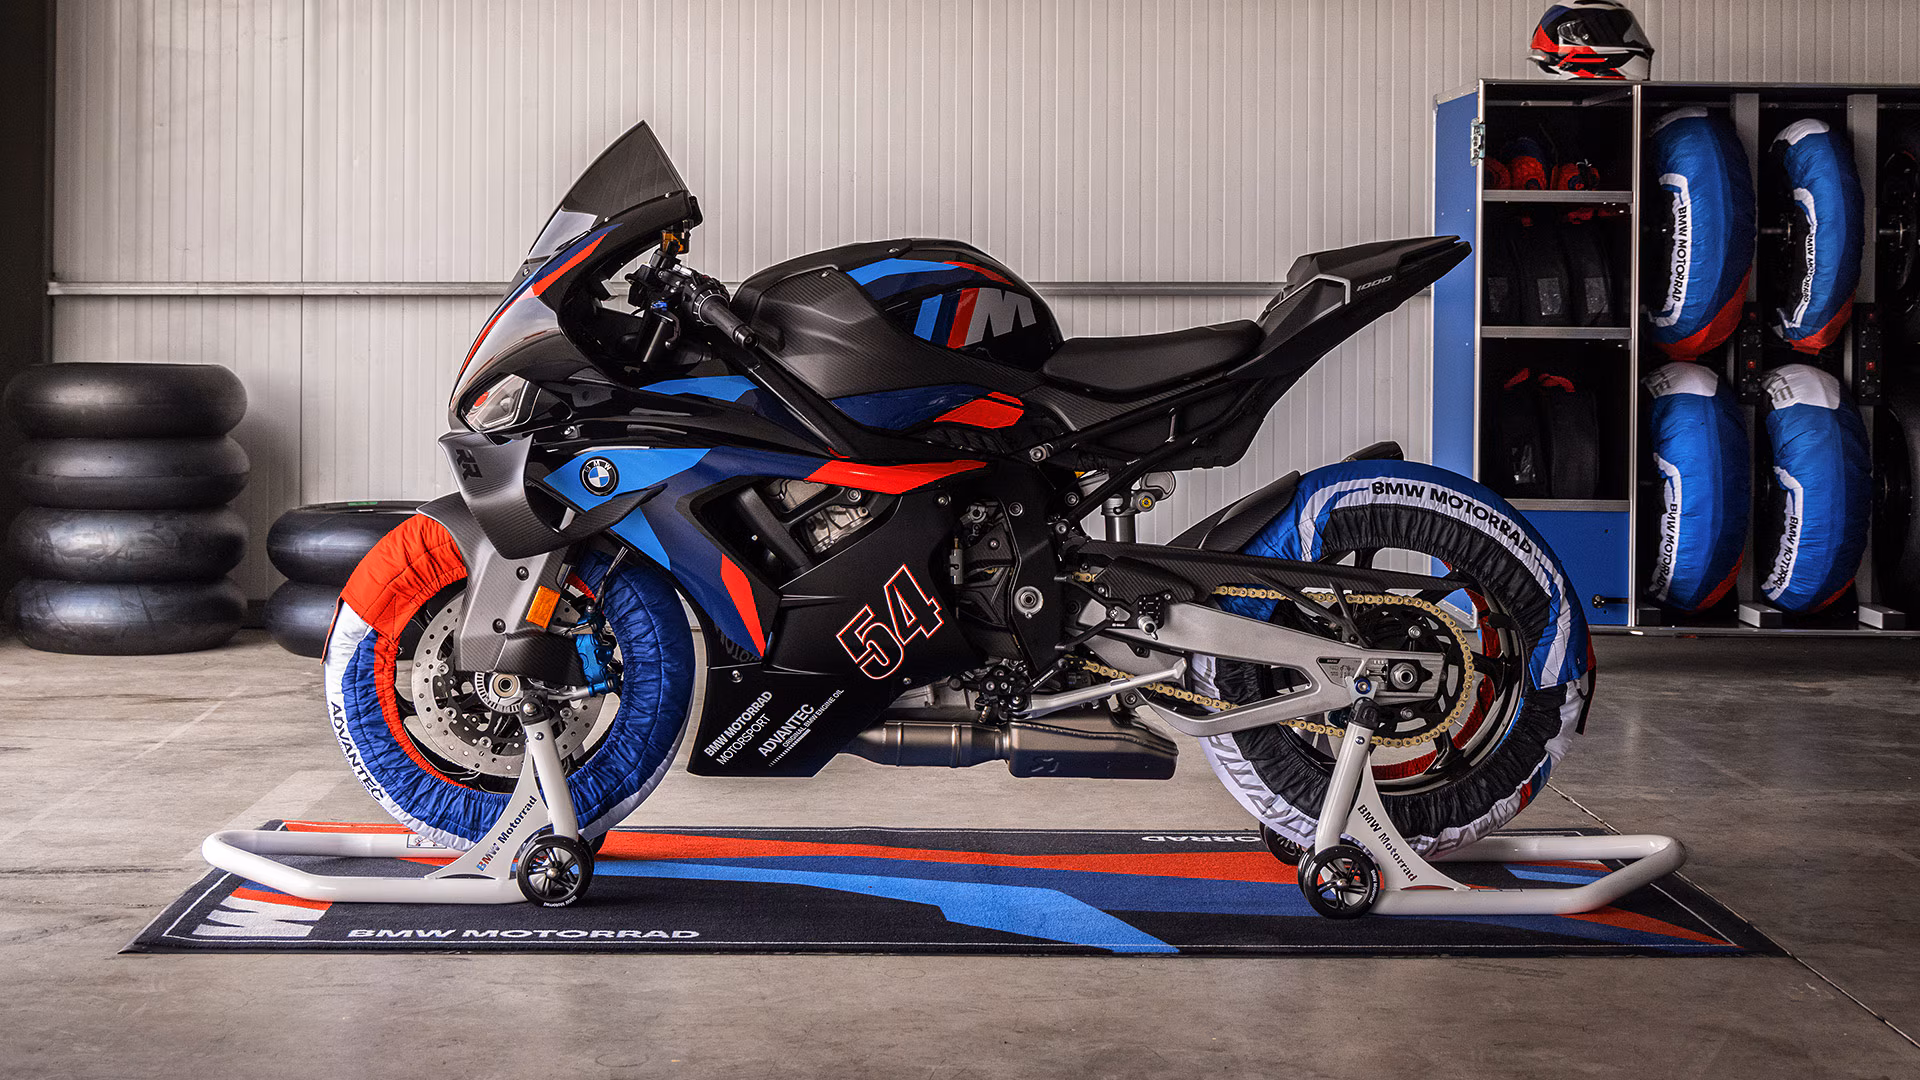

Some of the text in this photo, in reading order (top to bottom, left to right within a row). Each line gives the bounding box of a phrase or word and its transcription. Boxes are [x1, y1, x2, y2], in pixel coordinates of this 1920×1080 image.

[1356, 275, 1393, 292] 1000
[1672, 206, 1688, 302] BMW MOTORRAD
[964, 287, 1037, 346] M
[1371, 481, 1532, 554] BMW MOTORRAD
[1787, 516, 1799, 545] BMW
[836, 563, 944, 680] 54
[703, 691, 773, 757] BMW MOTORRAD
[758, 704, 815, 757] ADVANTEC
[814, 696, 836, 716] ENGINE
[832, 689, 845, 699] OIL
[331, 701, 384, 801] ADVANTEC
[716, 713, 771, 765] MOTORSPORT
[476, 795, 538, 872] BMW Motorrad
[1357, 804, 1418, 882] BMW Motorrad
[348, 929, 701, 939] BMW MOTORRAD
